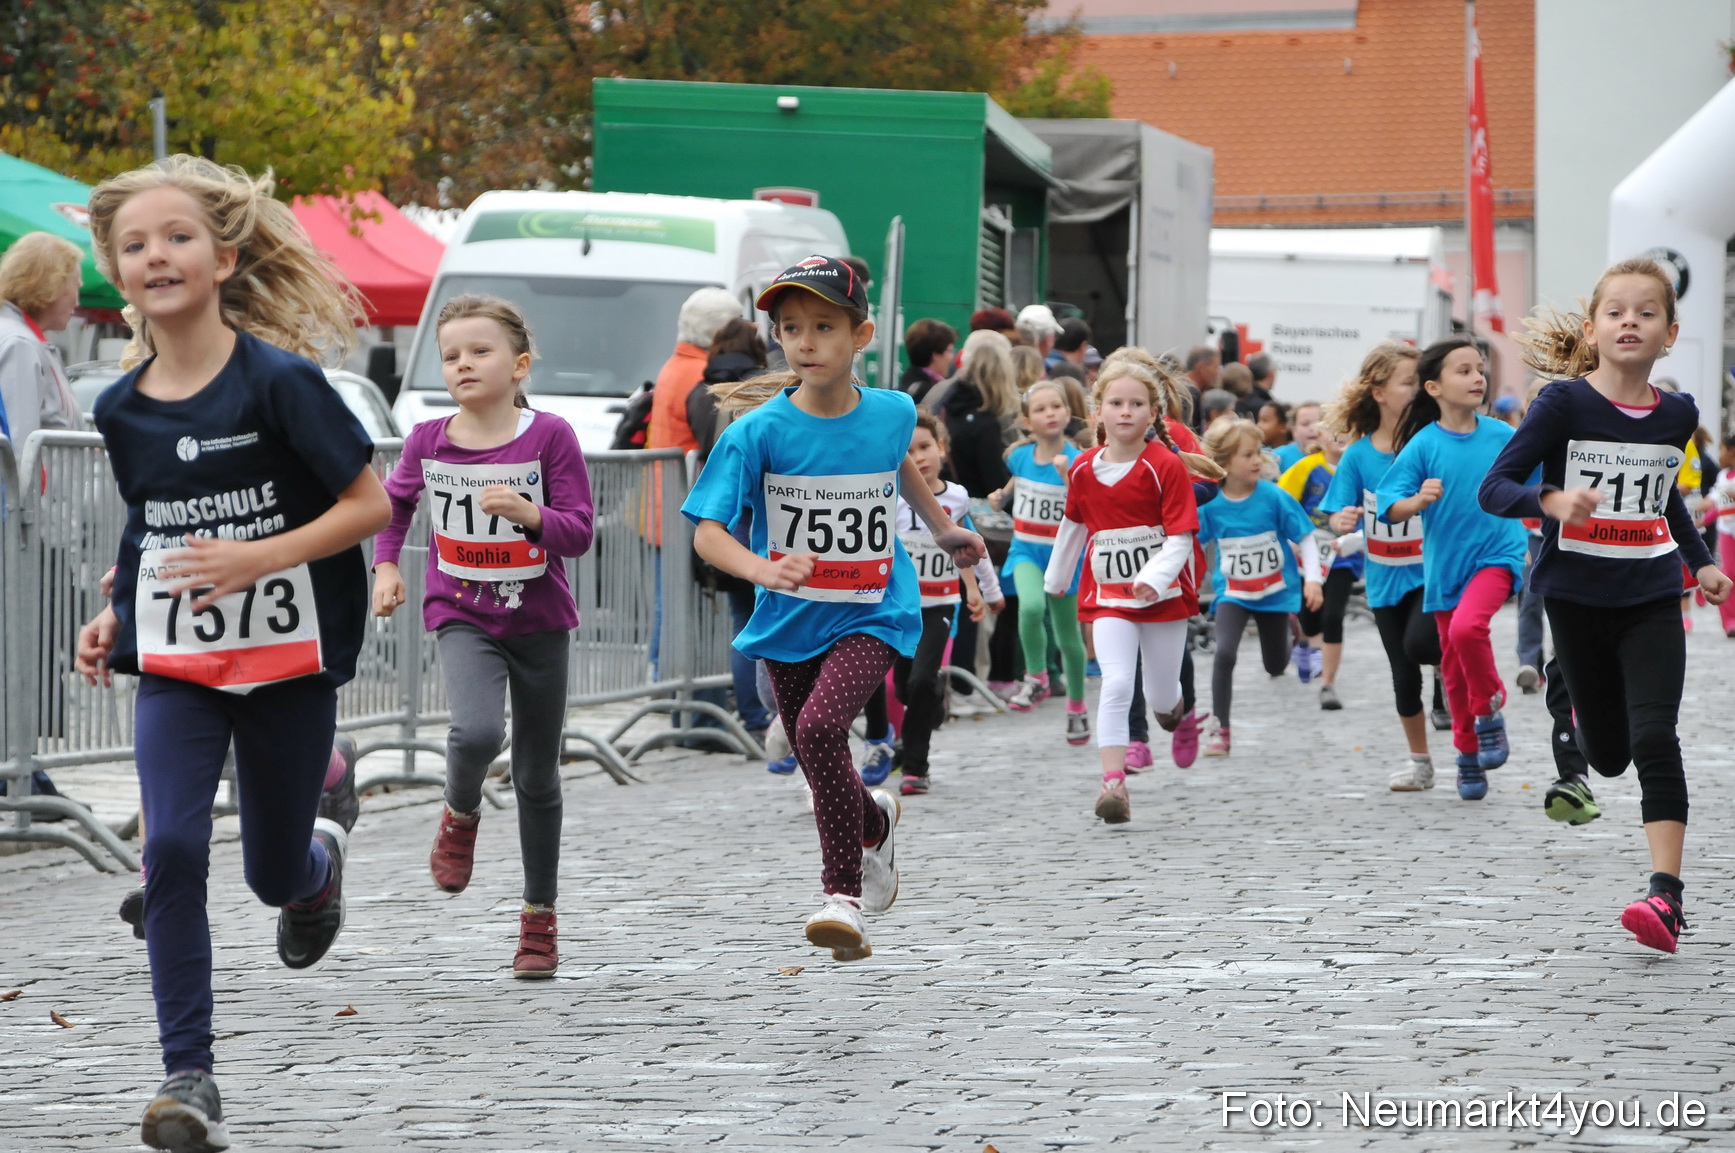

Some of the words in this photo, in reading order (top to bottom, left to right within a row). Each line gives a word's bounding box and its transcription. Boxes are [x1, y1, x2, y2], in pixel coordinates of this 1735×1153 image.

[1272, 324, 1361, 339] Bayerisches
[1271, 342, 1313, 355] Rotes
[1570, 451, 1613, 465] PARTL
[1616, 455, 1666, 467] Neumarkt
[425, 471, 458, 486] PARTL
[461, 476, 521, 487] Neumarkt
[768, 485, 811, 500] PARTL
[816, 488, 879, 500] Neumarkt
[1019, 493, 1064, 521] 7185
[780, 503, 888, 554] 7536
[1589, 524, 1653, 542] Johanna
[1118, 533, 1157, 545] Neumarkt
[456, 546, 511, 567] Sophia
[1228, 548, 1278, 575] 7579
[812, 565, 861, 578] Leonie
[152, 578, 300, 645] 7573
